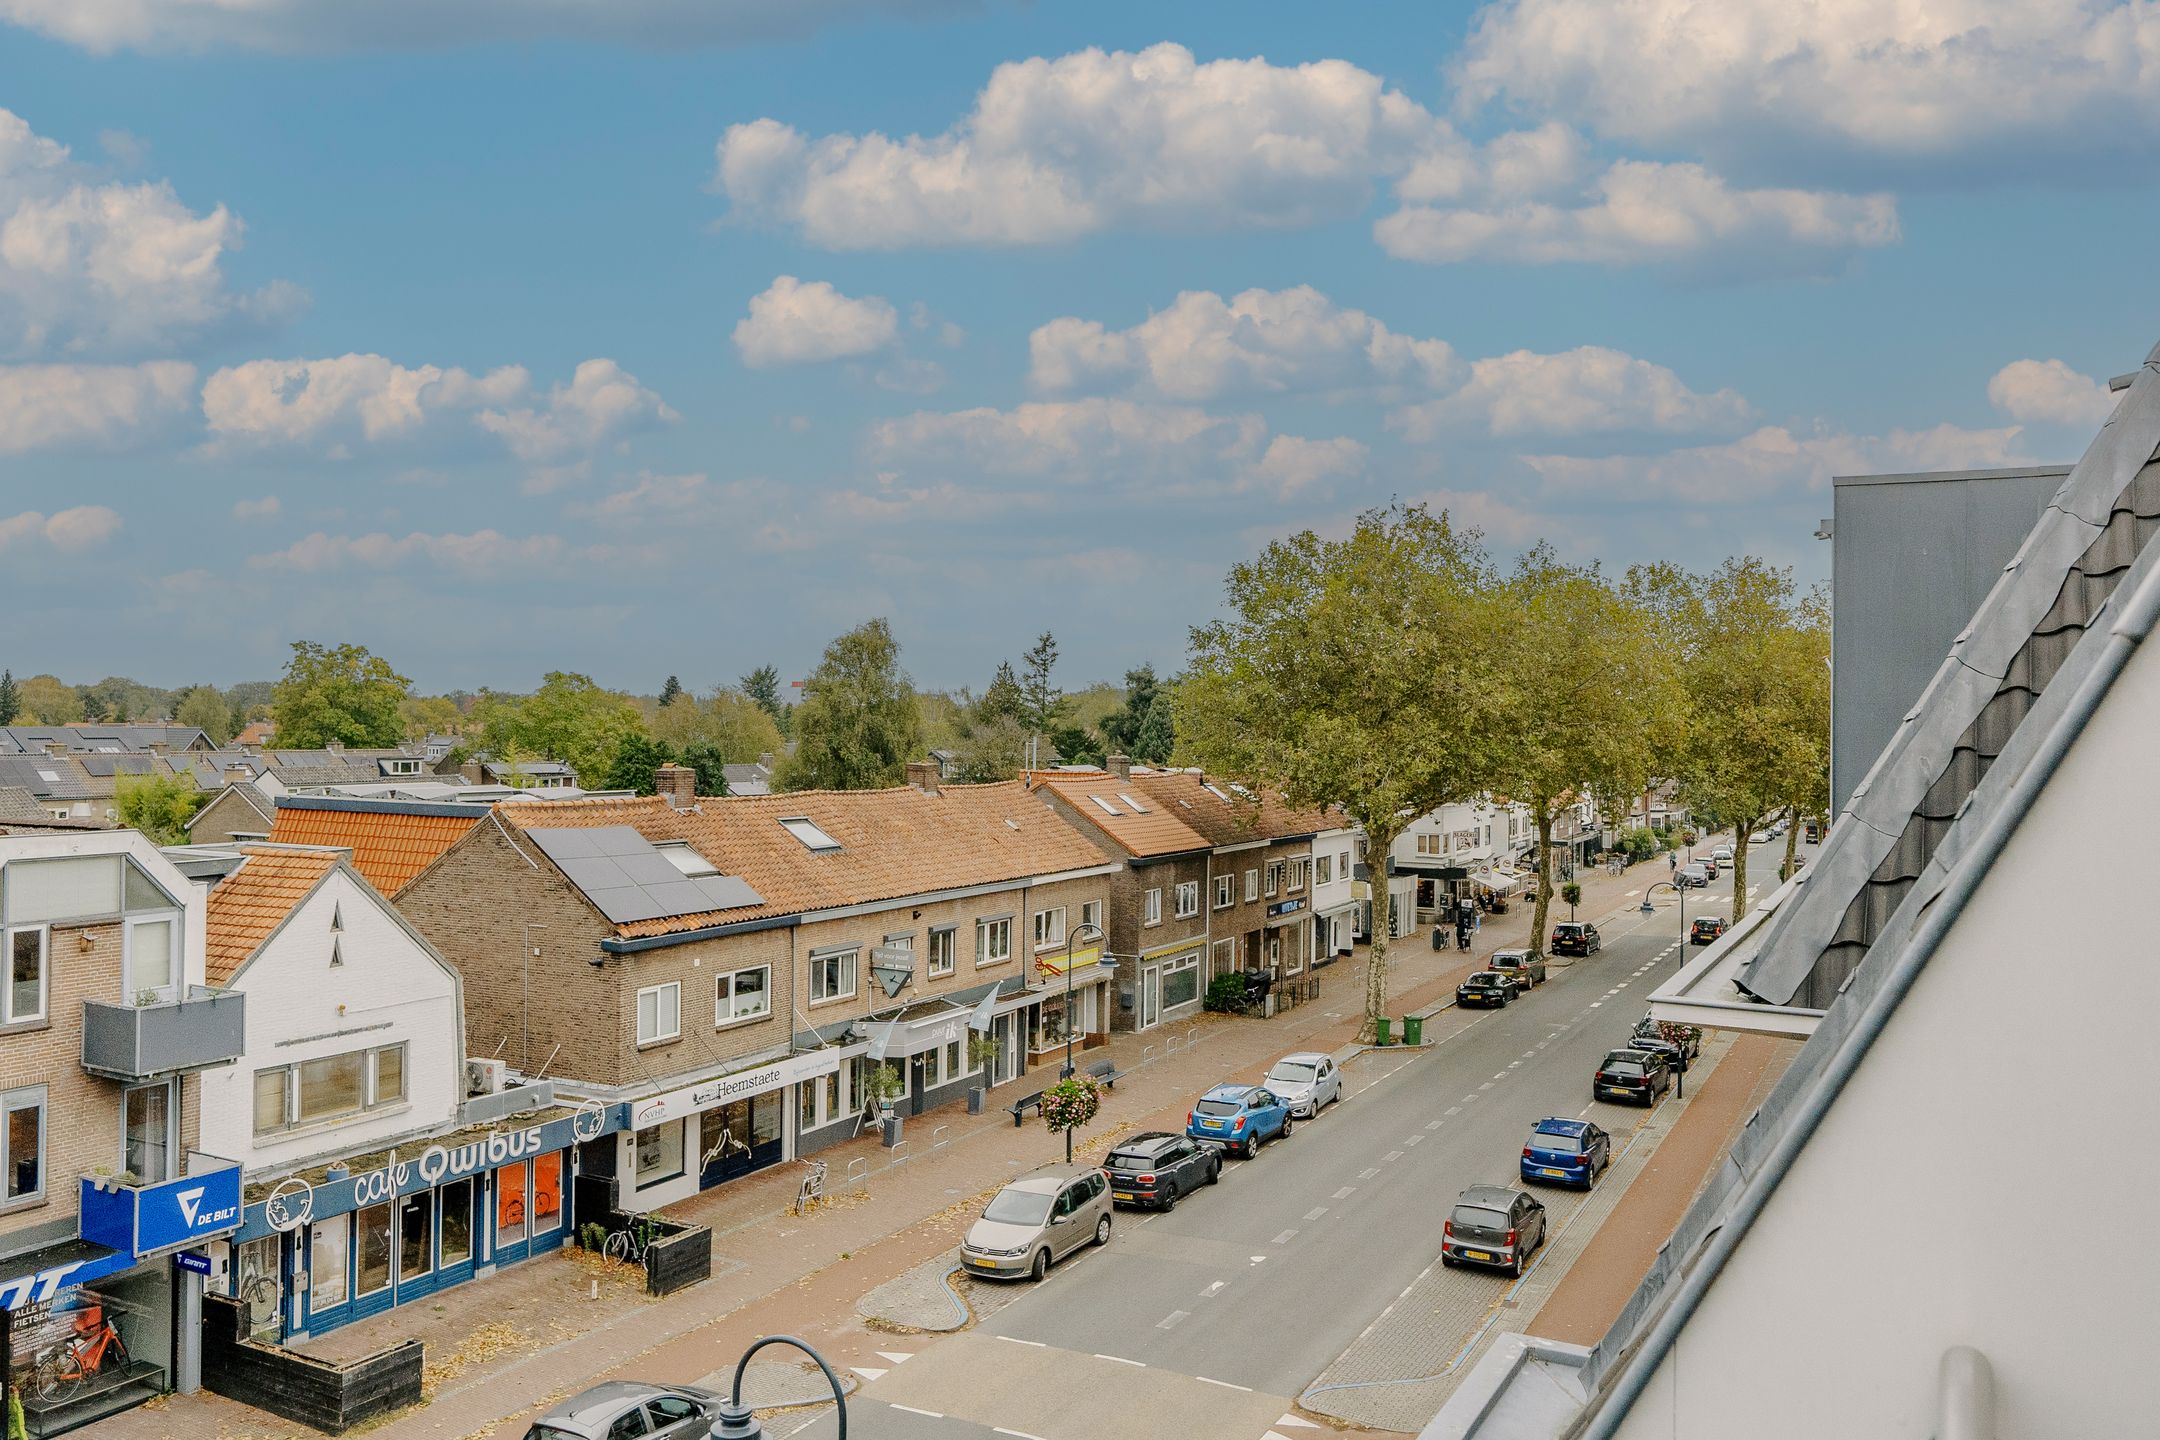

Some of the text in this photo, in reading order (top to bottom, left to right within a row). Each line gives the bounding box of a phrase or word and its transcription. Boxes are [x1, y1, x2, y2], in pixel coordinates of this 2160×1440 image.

[717, 1069, 781, 1097] Heemstaete
[644, 1107, 665, 1120] NVHP
[354, 1149, 410, 1206] cafe
[197, 1206, 237, 1226] DE BILT
[13, 1304, 38, 1319] ALLE
[39, 1293, 78, 1311] MERKEN
[13, 1310, 53, 1329] FIETSEN
